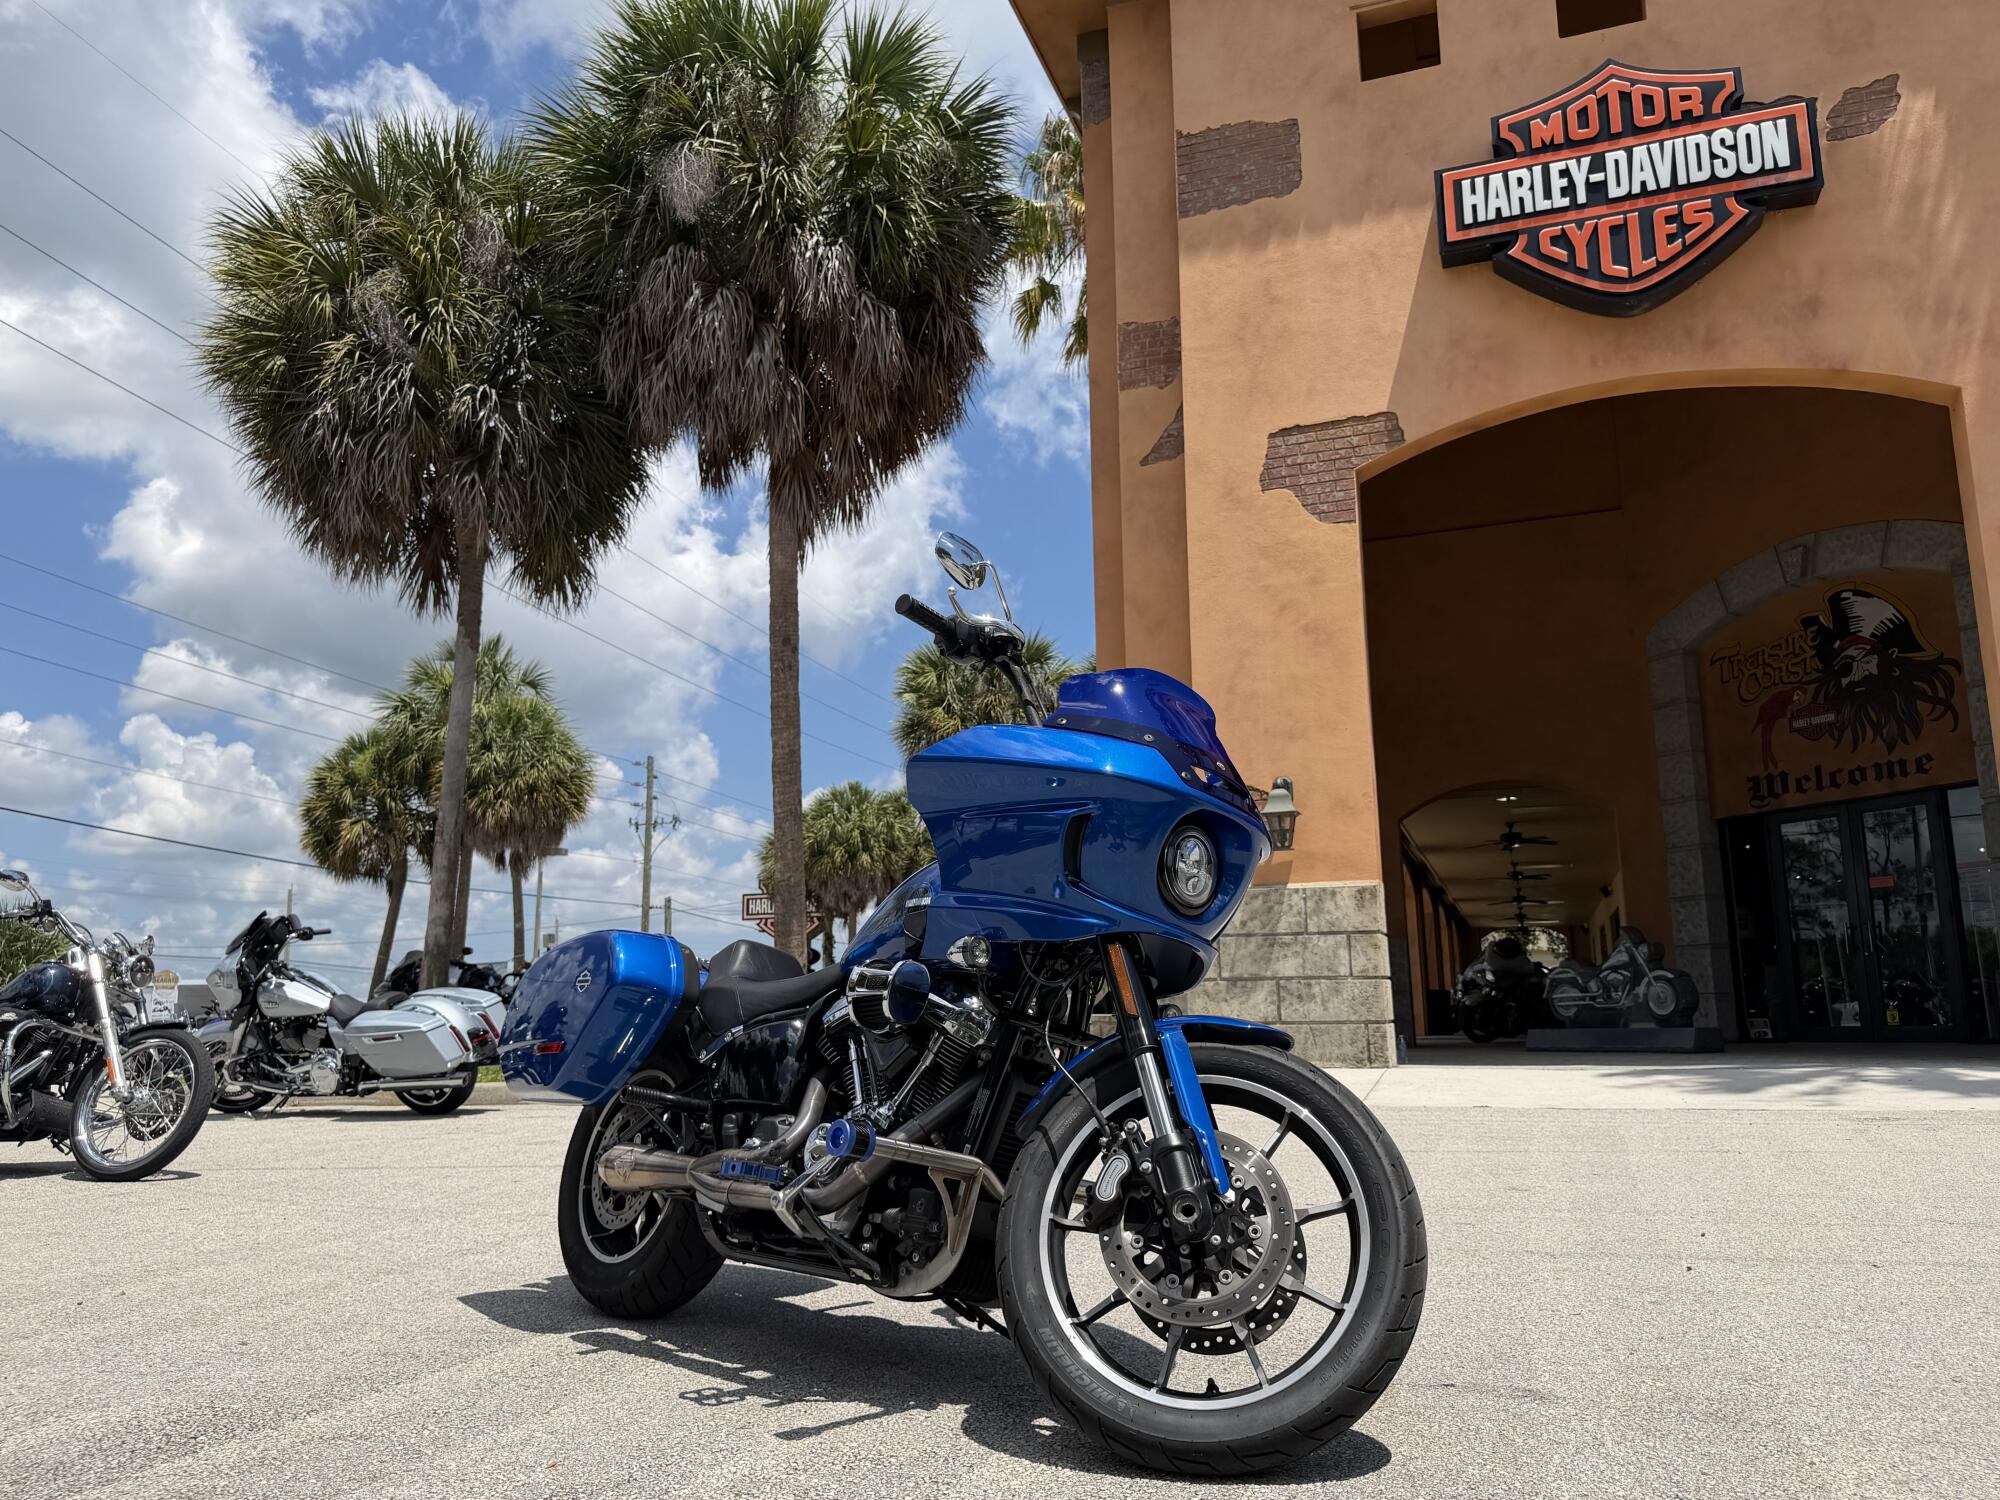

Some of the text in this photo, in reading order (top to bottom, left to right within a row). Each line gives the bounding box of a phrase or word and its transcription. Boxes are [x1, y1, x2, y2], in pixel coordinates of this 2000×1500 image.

[1529, 78, 1704, 149] MOTOR
[1460, 118, 1791, 226] HARLEY-DAVIDSON
[1539, 198, 1715, 278] CYCLES
[1747, 752, 1935, 808] Welcome
[1038, 1325, 1115, 1406] MICHELIN
